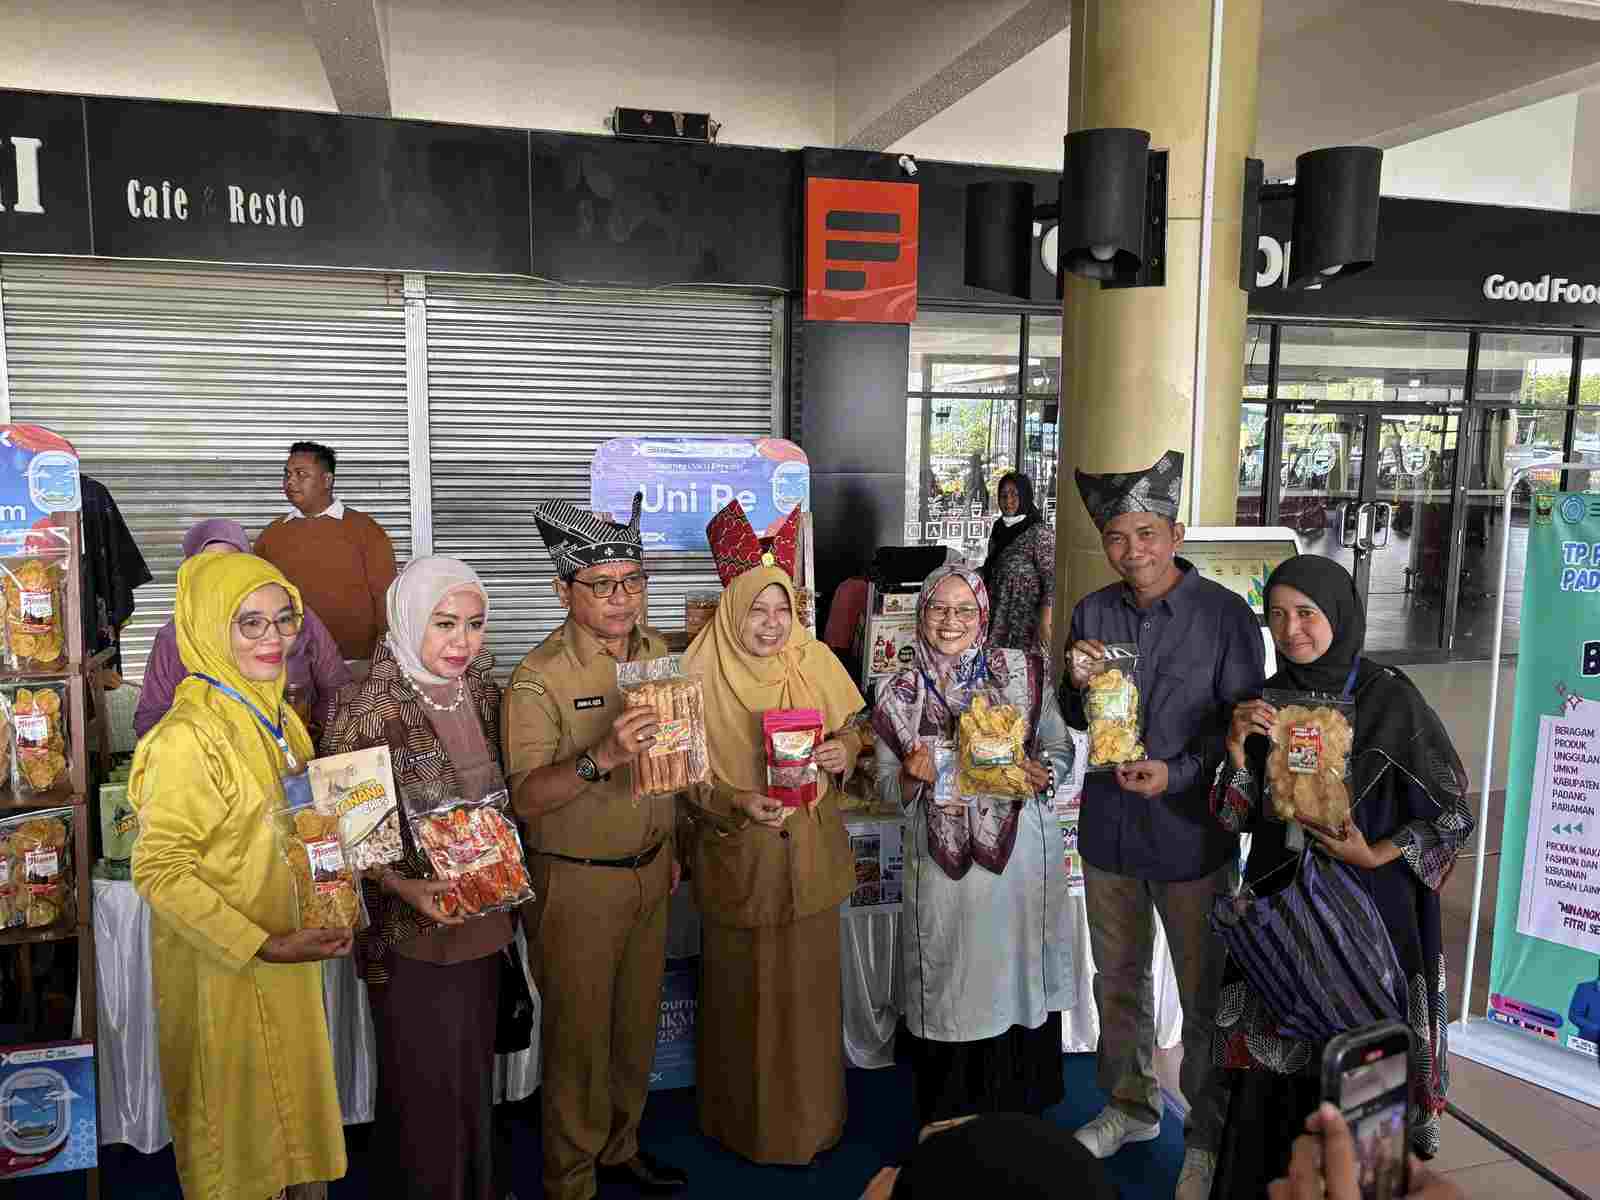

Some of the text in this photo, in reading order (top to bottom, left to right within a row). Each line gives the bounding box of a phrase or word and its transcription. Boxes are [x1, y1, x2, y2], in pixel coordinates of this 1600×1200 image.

[0, 136, 45, 214] I
[127, 179, 188, 219] Cafe
[228, 185, 304, 227] Resto
[1482, 274, 1600, 304] GoodFoo
[640, 482, 697, 513] Uni
[1555, 726, 1594, 738] BERAGAM
[1554, 738, 1587, 750] PRODUK
[1554, 751, 1600, 764] UNGGULAN
[1553, 776, 1600, 790] KABUPATEN
[1552, 789, 1586, 801] PADANG
[1551, 802, 1595, 816] PARIAMAN
[1545, 853, 1579, 866] FASHION
[1544, 877, 1577, 891] TANGAN
[1563, 917, 1587, 932] FITRI
